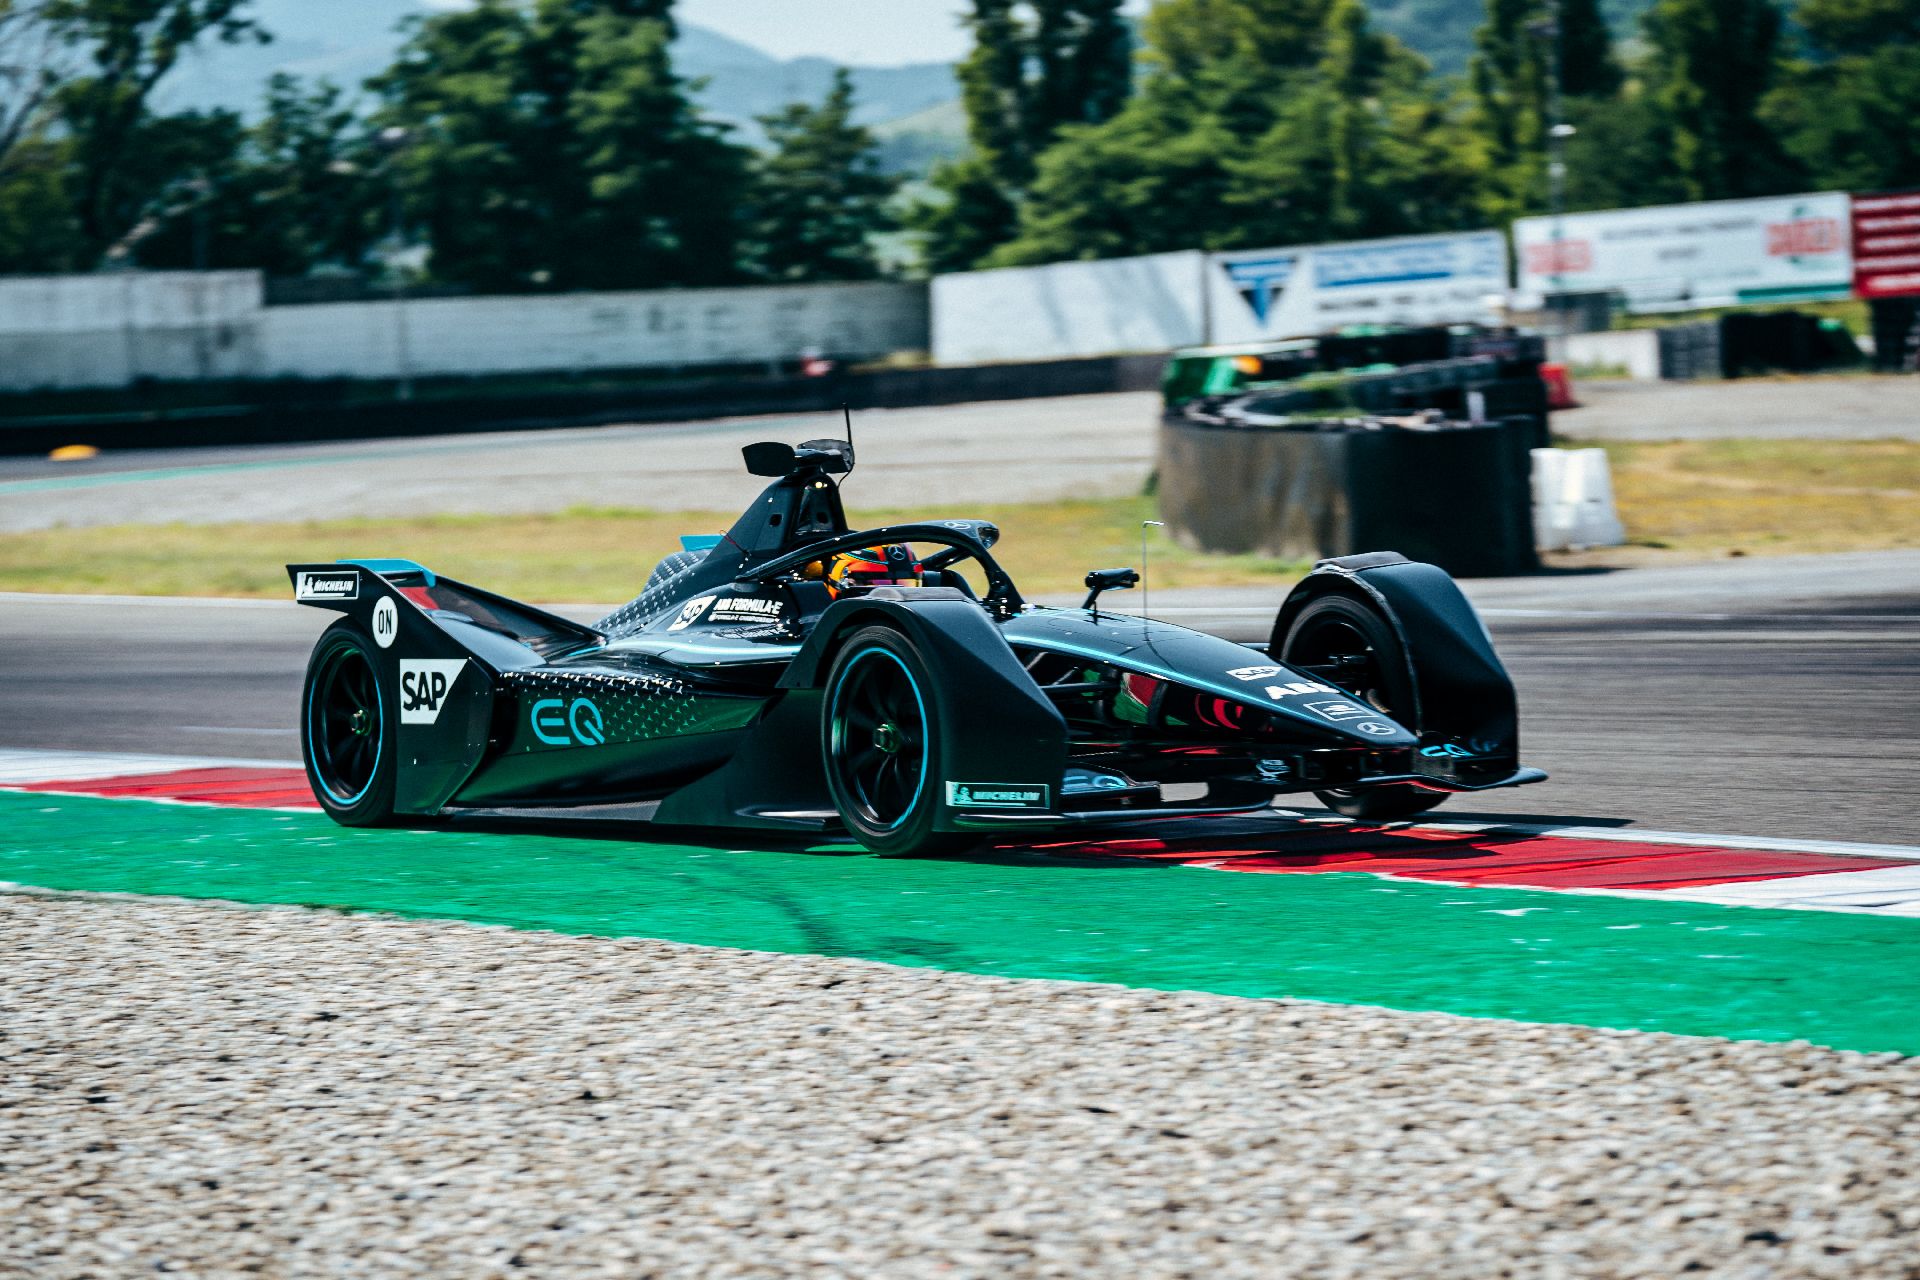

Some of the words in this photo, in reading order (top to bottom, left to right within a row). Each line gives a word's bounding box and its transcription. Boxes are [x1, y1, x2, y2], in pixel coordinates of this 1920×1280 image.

[313, 579, 354, 592] MICHELIN
[378, 609, 392, 635] ON
[402, 671, 447, 711] SAP
[531, 698, 606, 745] EQ
